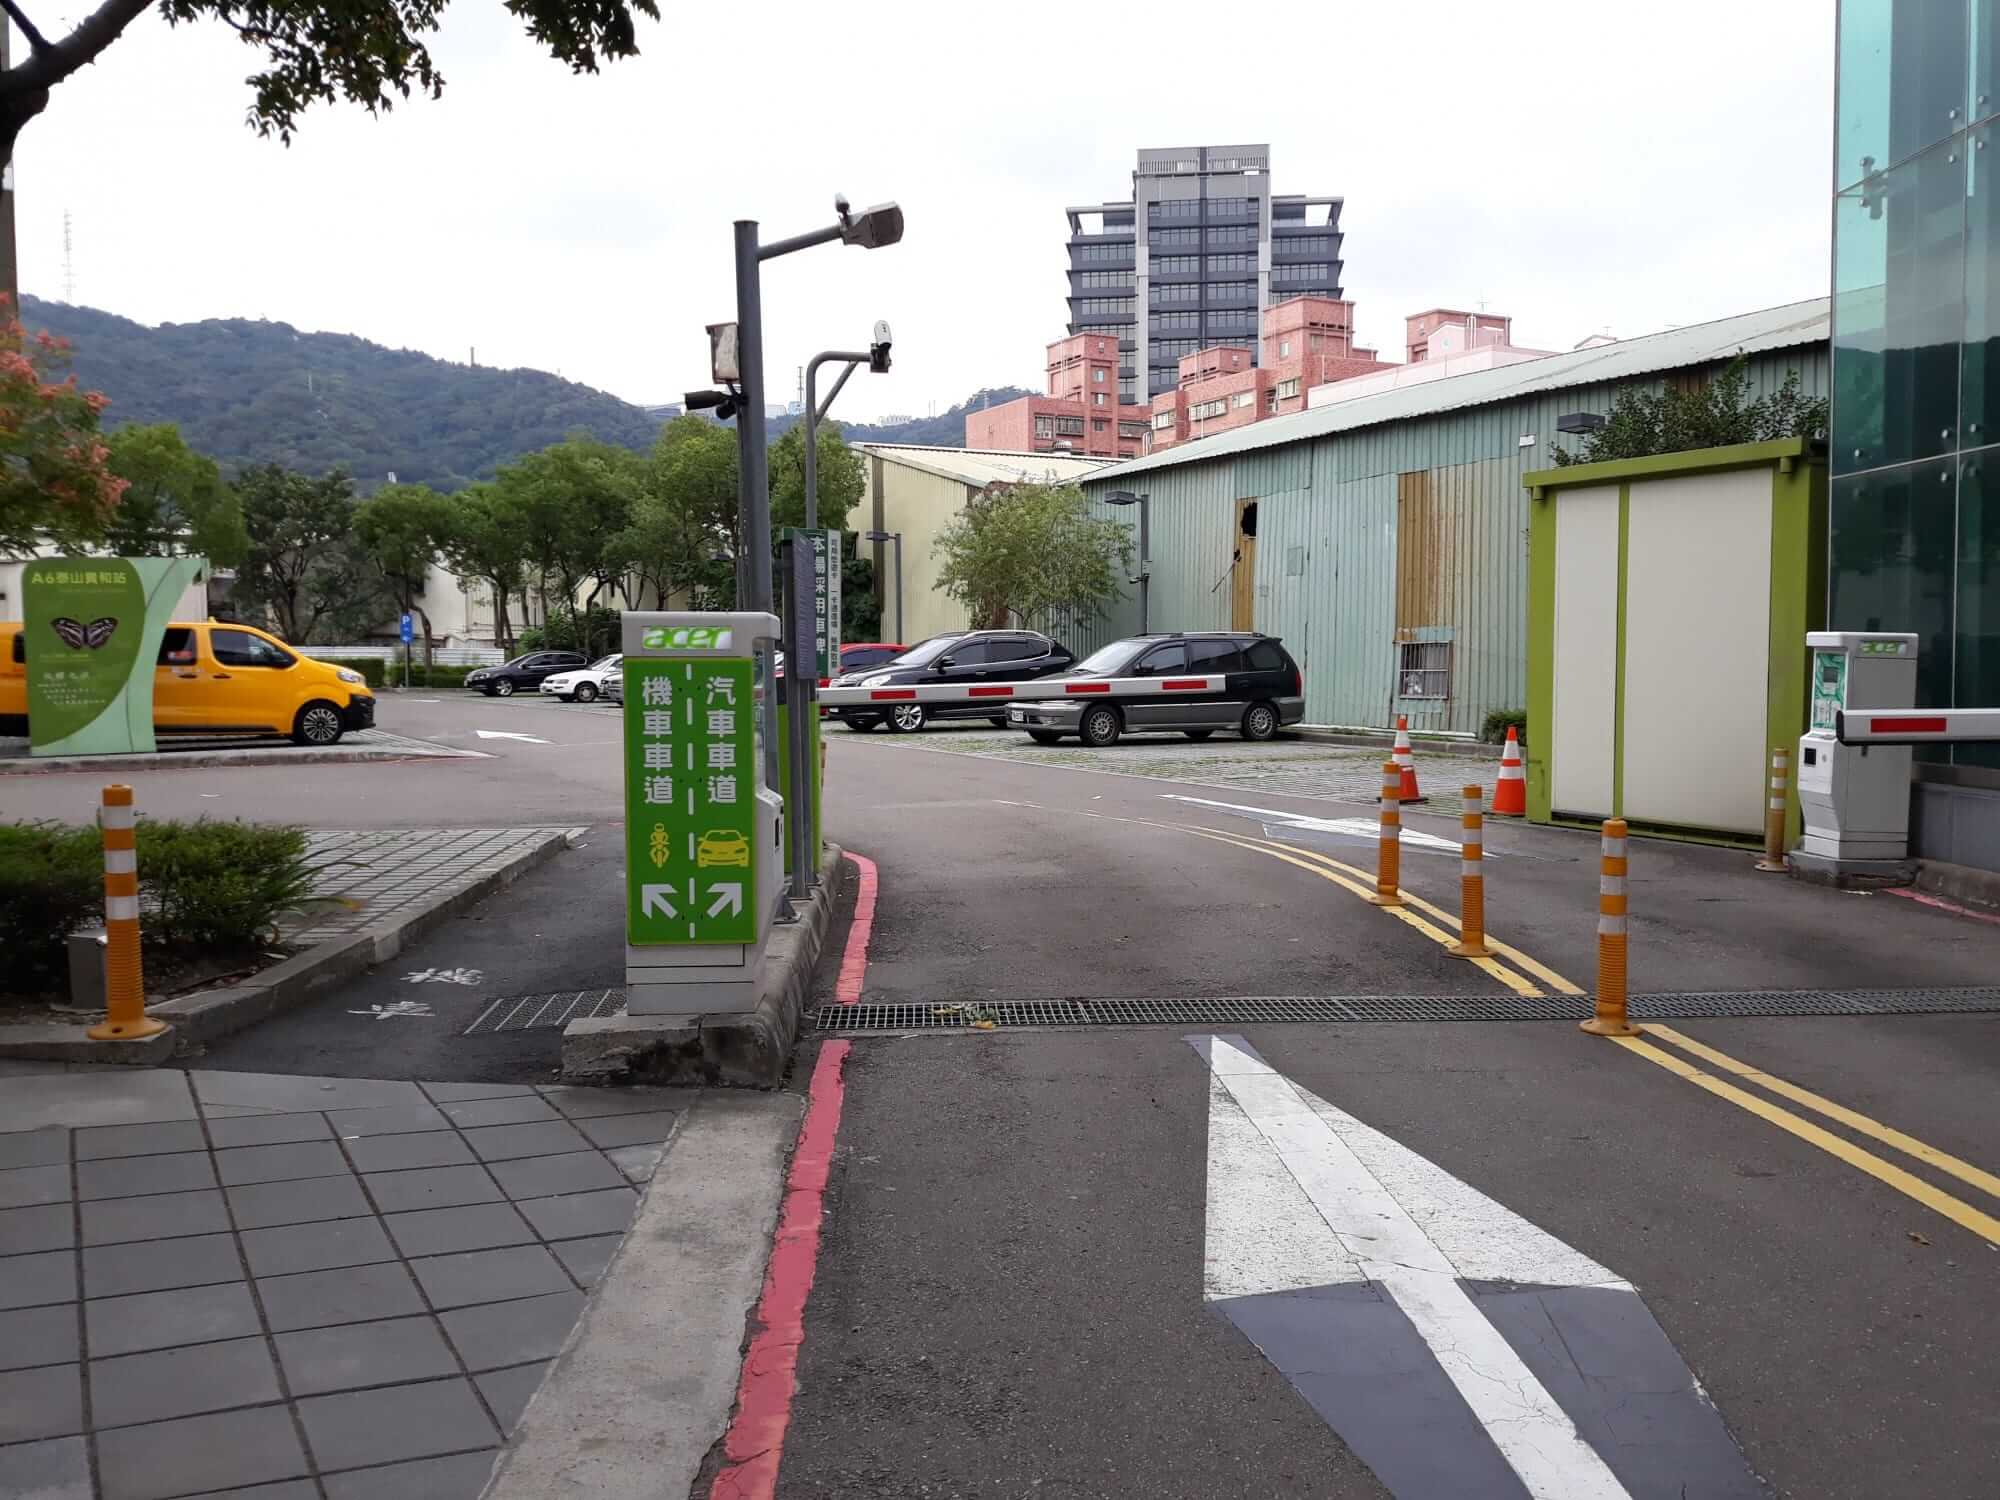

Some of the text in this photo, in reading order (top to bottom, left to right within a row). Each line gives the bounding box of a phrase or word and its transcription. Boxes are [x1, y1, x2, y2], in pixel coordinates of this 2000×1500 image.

[402, 615, 410, 624] P
[643, 626, 728, 649] acer
[641, 676, 673, 804] 機車車道
[706, 676, 737, 804] 汽車車道
